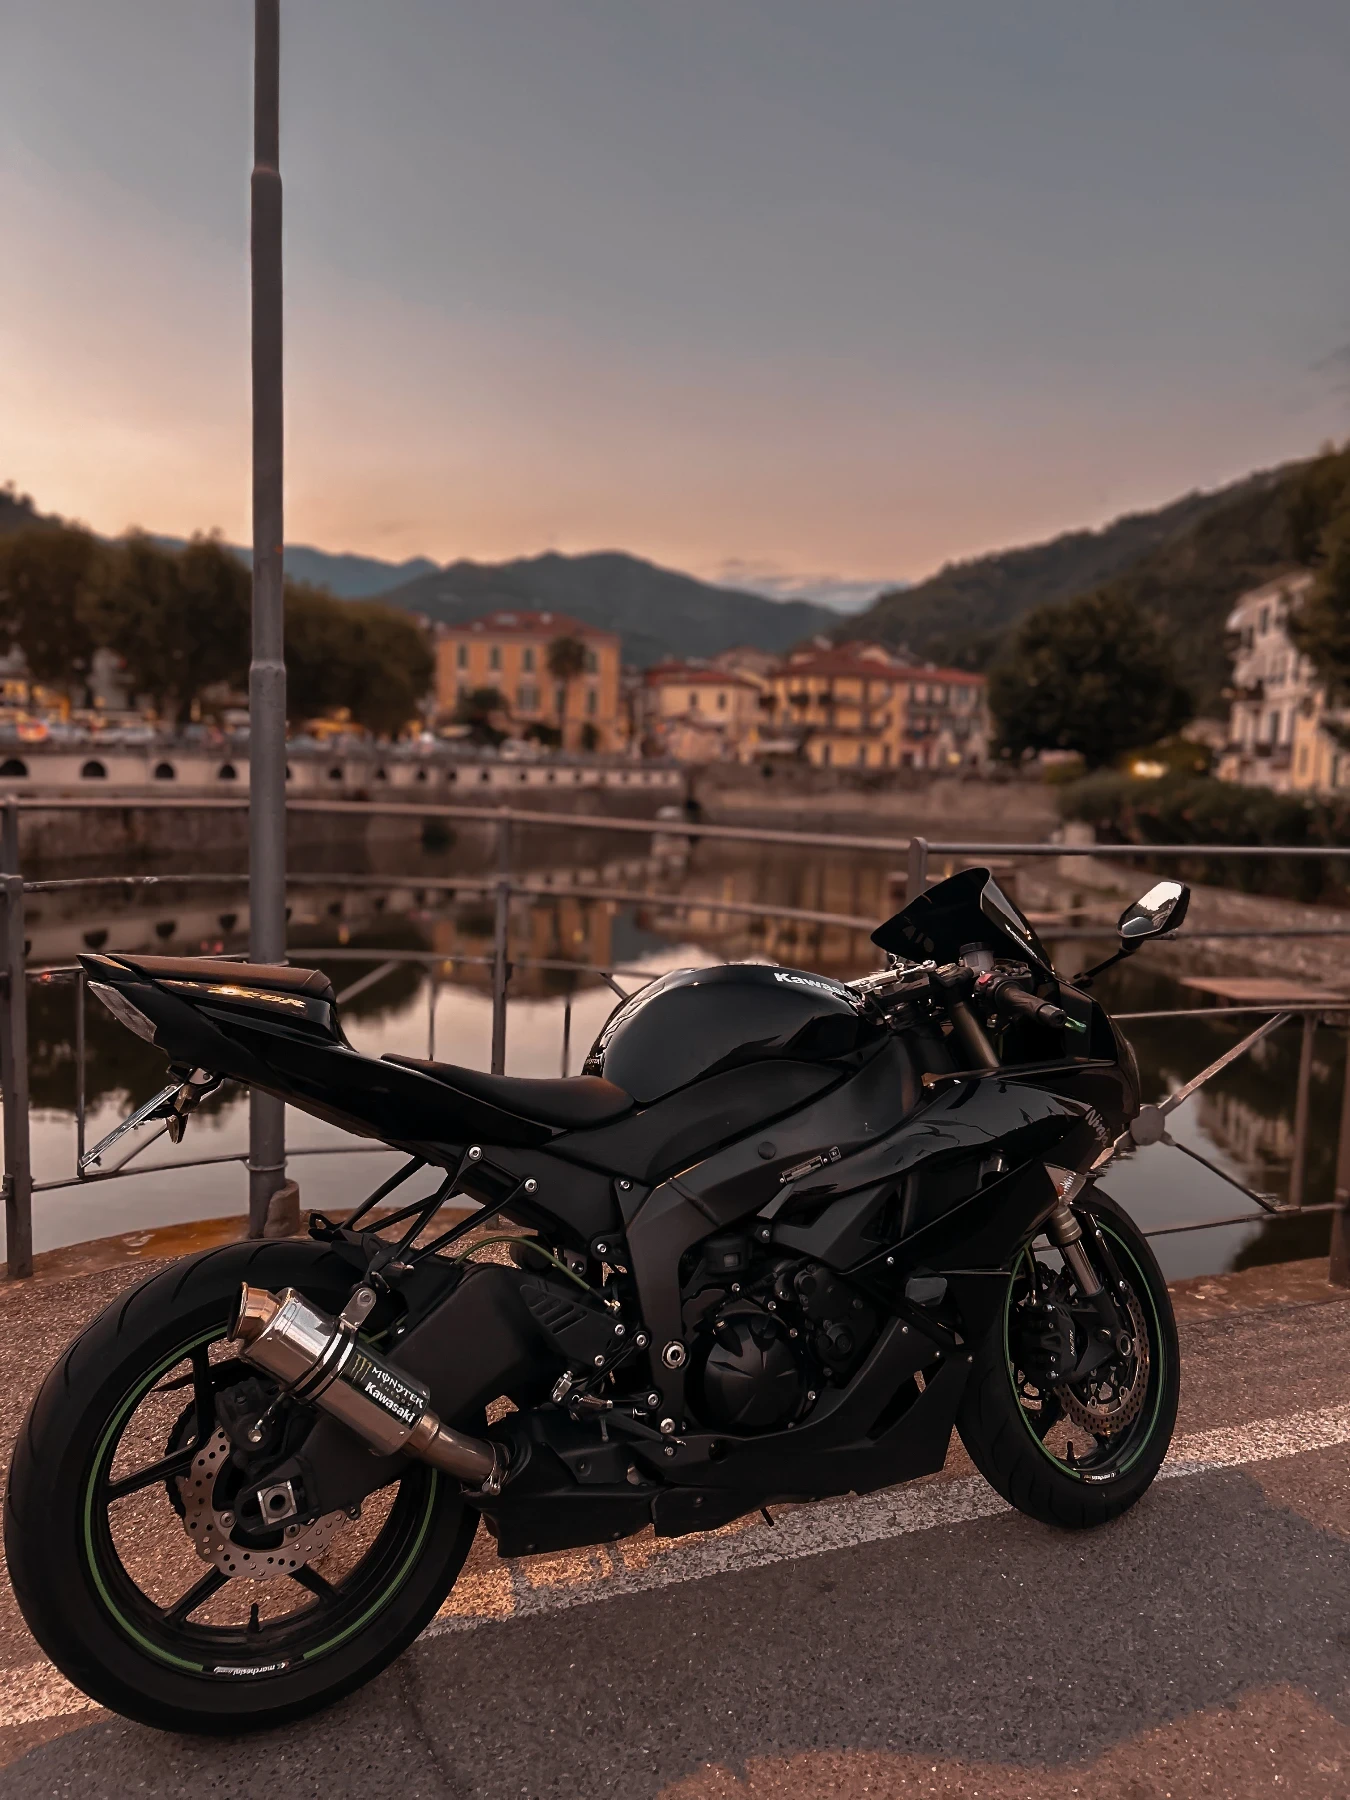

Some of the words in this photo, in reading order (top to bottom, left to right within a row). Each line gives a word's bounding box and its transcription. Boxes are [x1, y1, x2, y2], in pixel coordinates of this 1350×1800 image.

[1085, 1109, 1111, 1148] Ninja
[364, 1381, 416, 1423] Kawasaki
[371, 1366, 424, 1408] MONSTER
